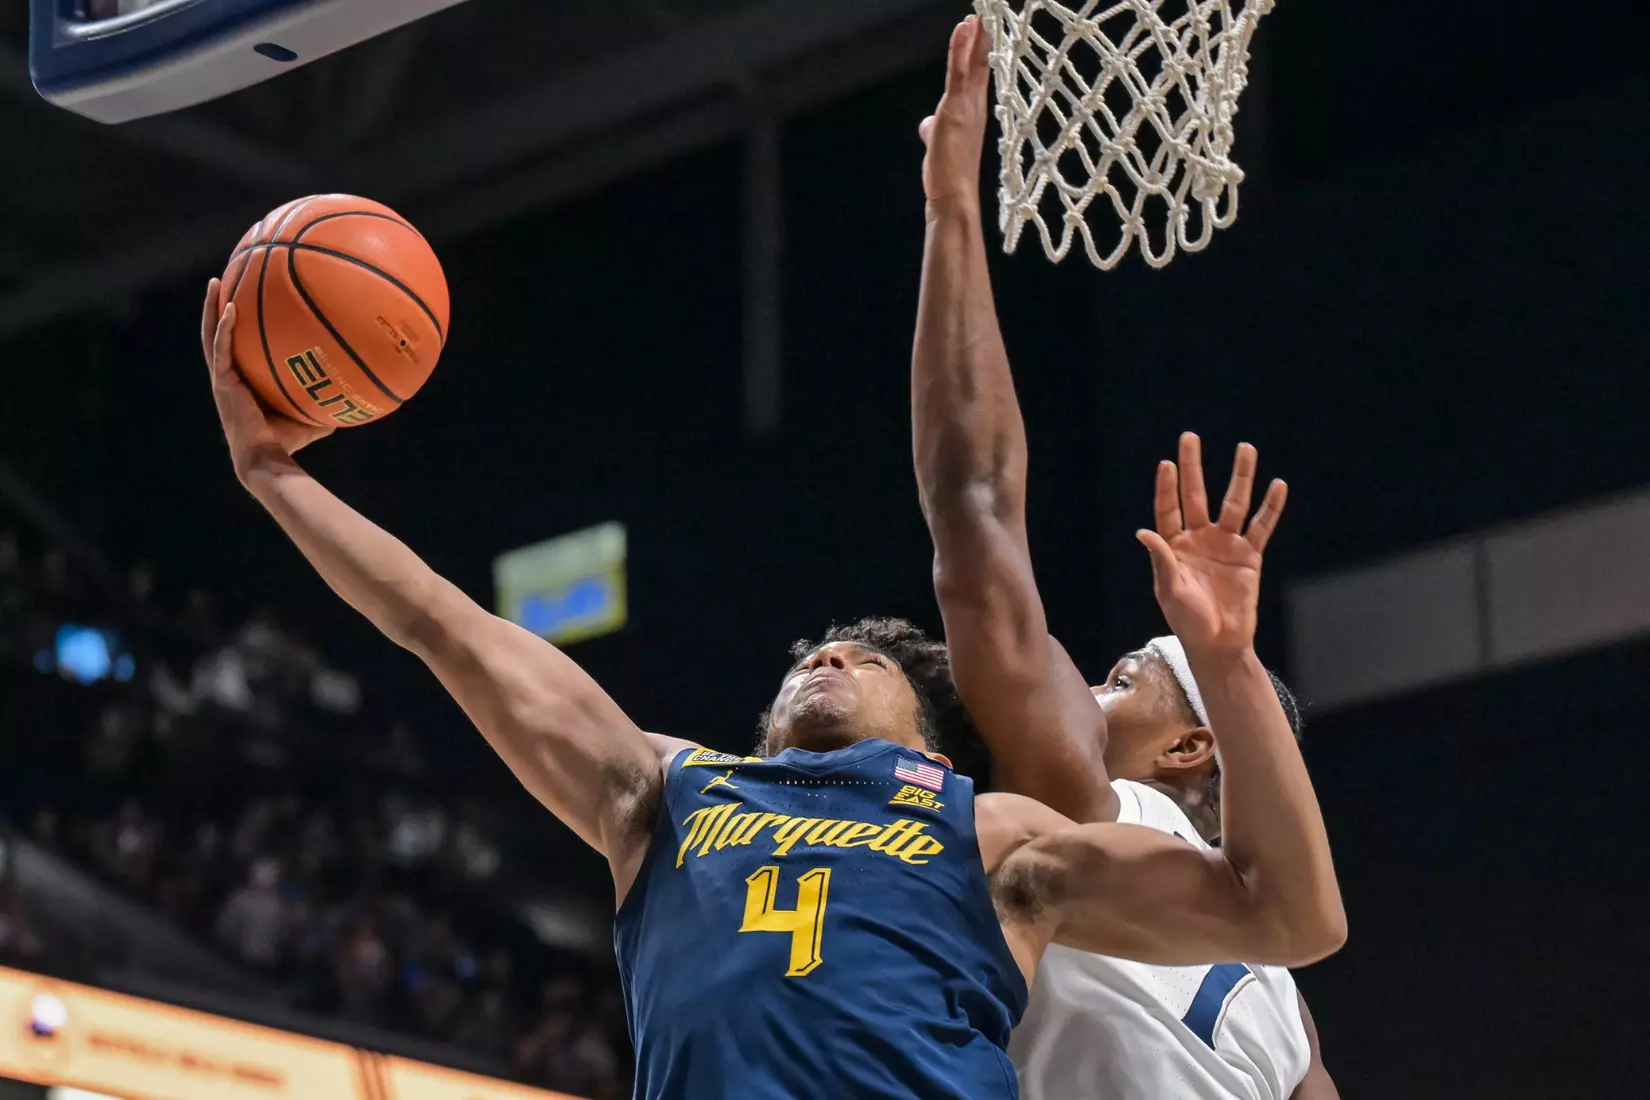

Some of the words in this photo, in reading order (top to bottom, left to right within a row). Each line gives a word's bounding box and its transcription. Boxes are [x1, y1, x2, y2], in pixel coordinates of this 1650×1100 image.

[285, 348, 375, 425] ELITE
[893, 792, 945, 809] EAST
[900, 785, 937, 799] BIG
[676, 802, 945, 869] Marquette
[738, 865, 831, 976] 4
